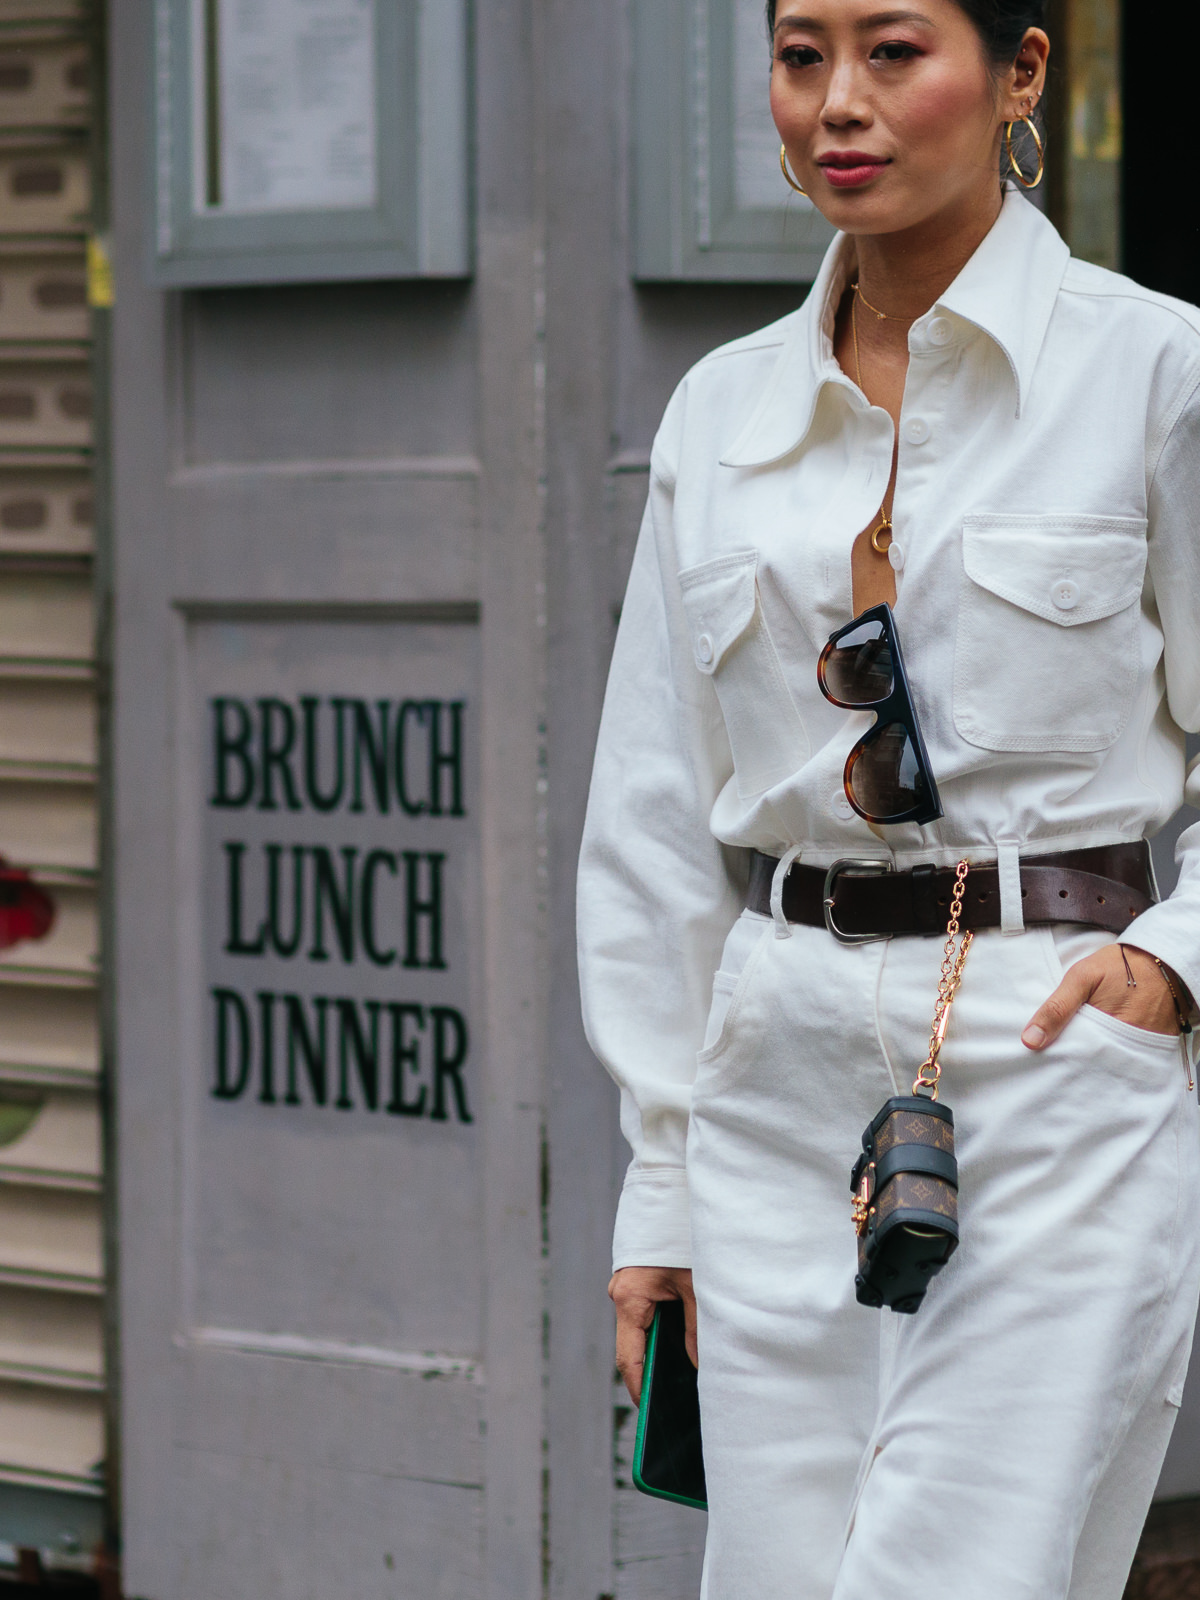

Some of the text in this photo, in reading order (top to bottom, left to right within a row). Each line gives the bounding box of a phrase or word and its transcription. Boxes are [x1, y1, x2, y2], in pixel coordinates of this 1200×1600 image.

[210, 696, 465, 817] BRUNCH
[225, 842, 447, 970] LUNCH
[211, 987, 474, 1123] DINNER
